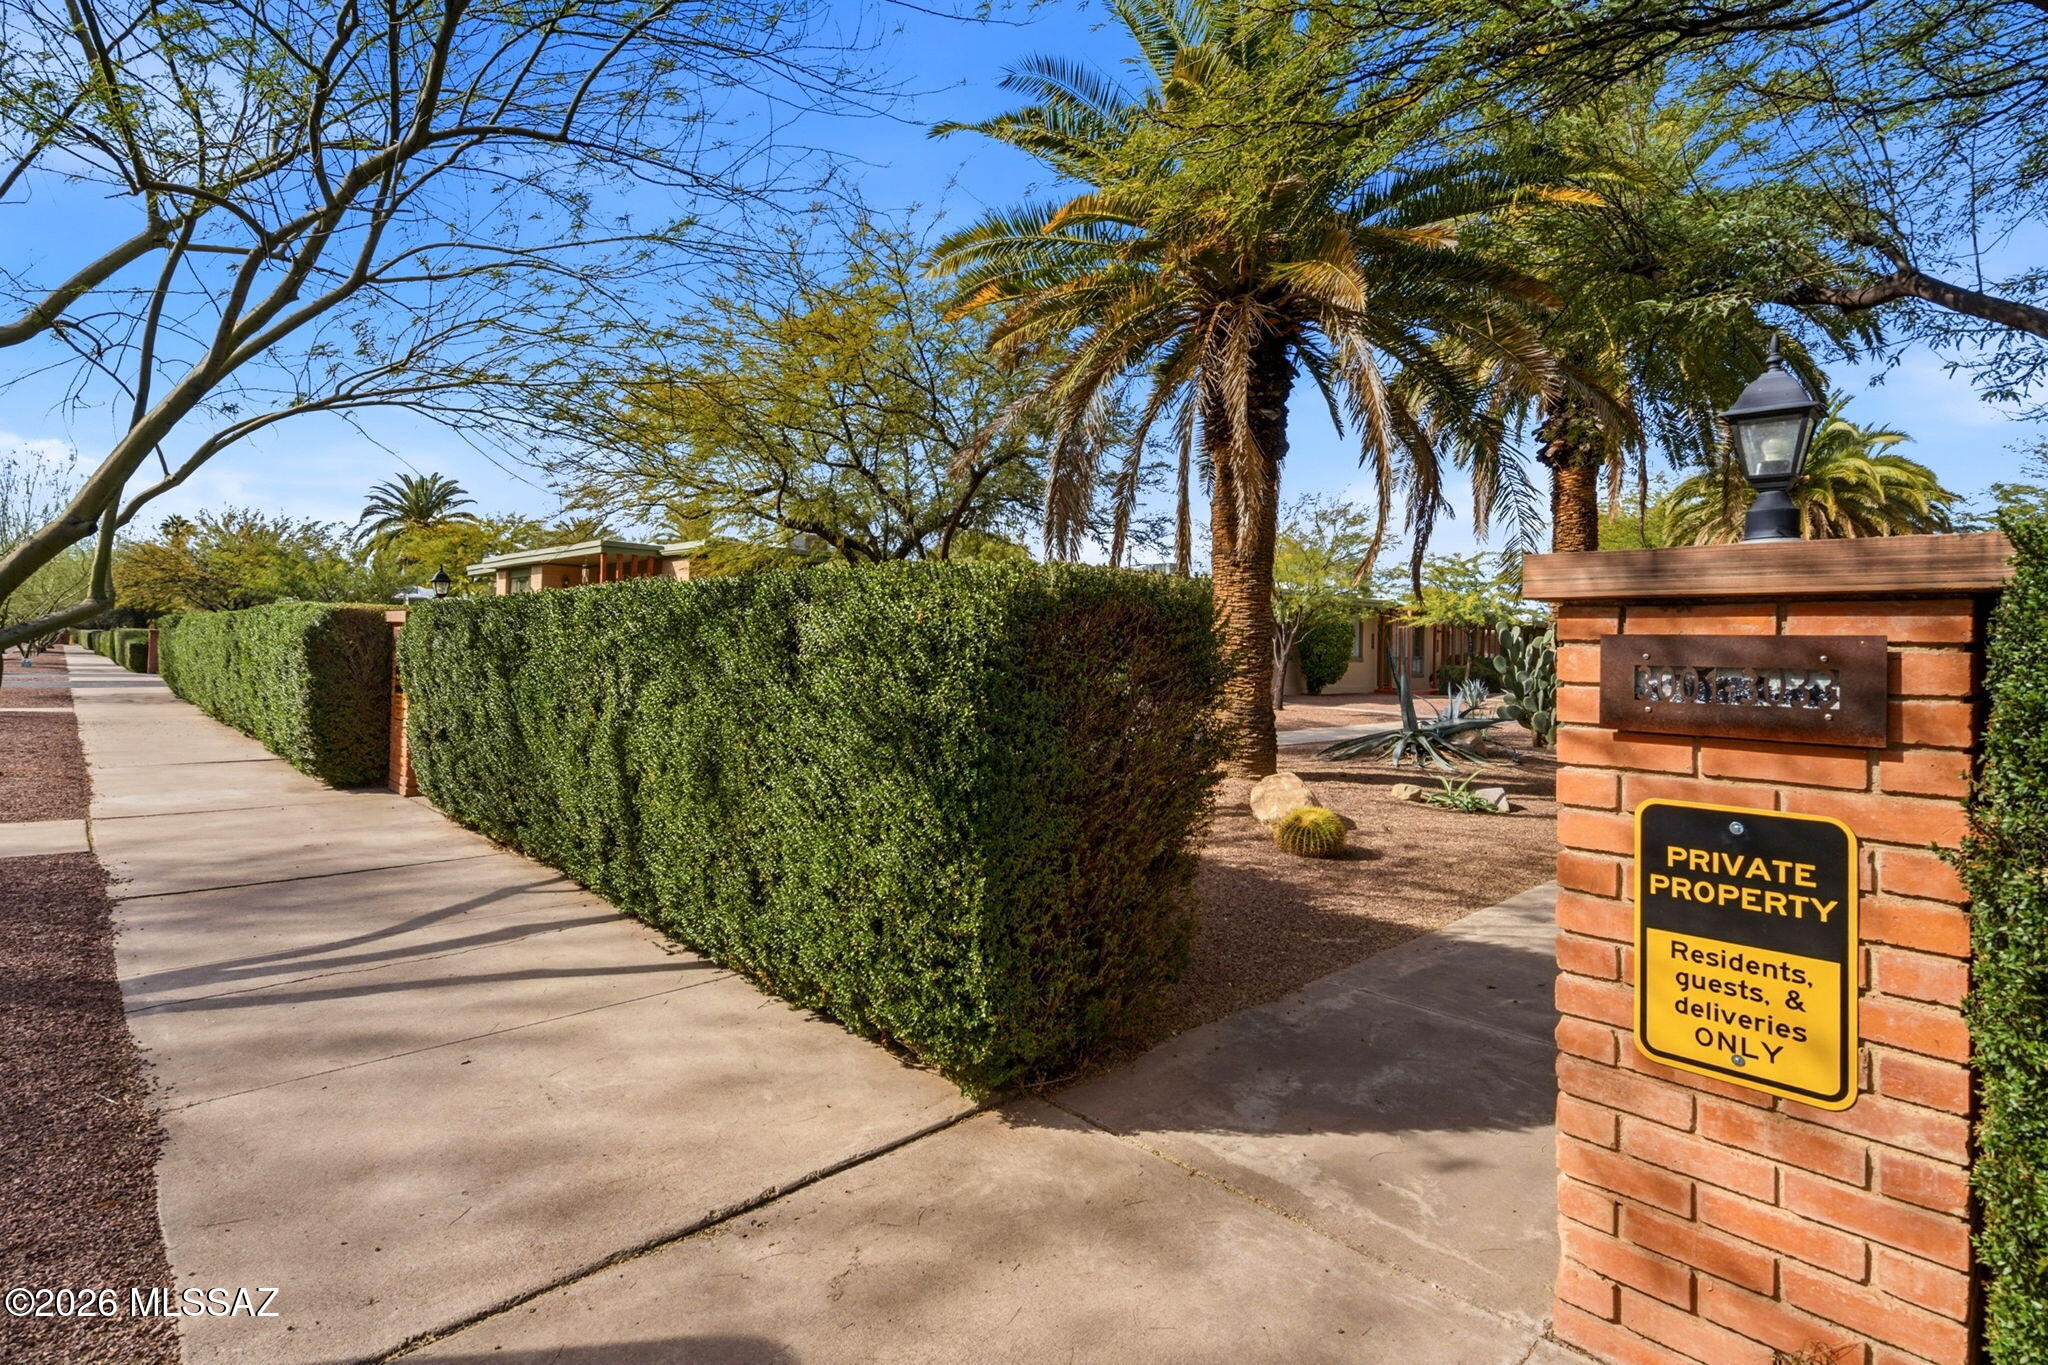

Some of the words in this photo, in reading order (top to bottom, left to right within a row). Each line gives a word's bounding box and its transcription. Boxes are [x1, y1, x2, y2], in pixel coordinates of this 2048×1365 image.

[1667, 846, 1817, 888] PRIVATE
[1650, 874, 1838, 923] PROPERTY
[1671, 940, 1813, 988] Residents,
[1676, 971, 1770, 1006] guests,
[1785, 990, 1806, 1013] &
[1675, 997, 1808, 1042] deliveries
[1695, 1027, 1784, 1064] ONLY
